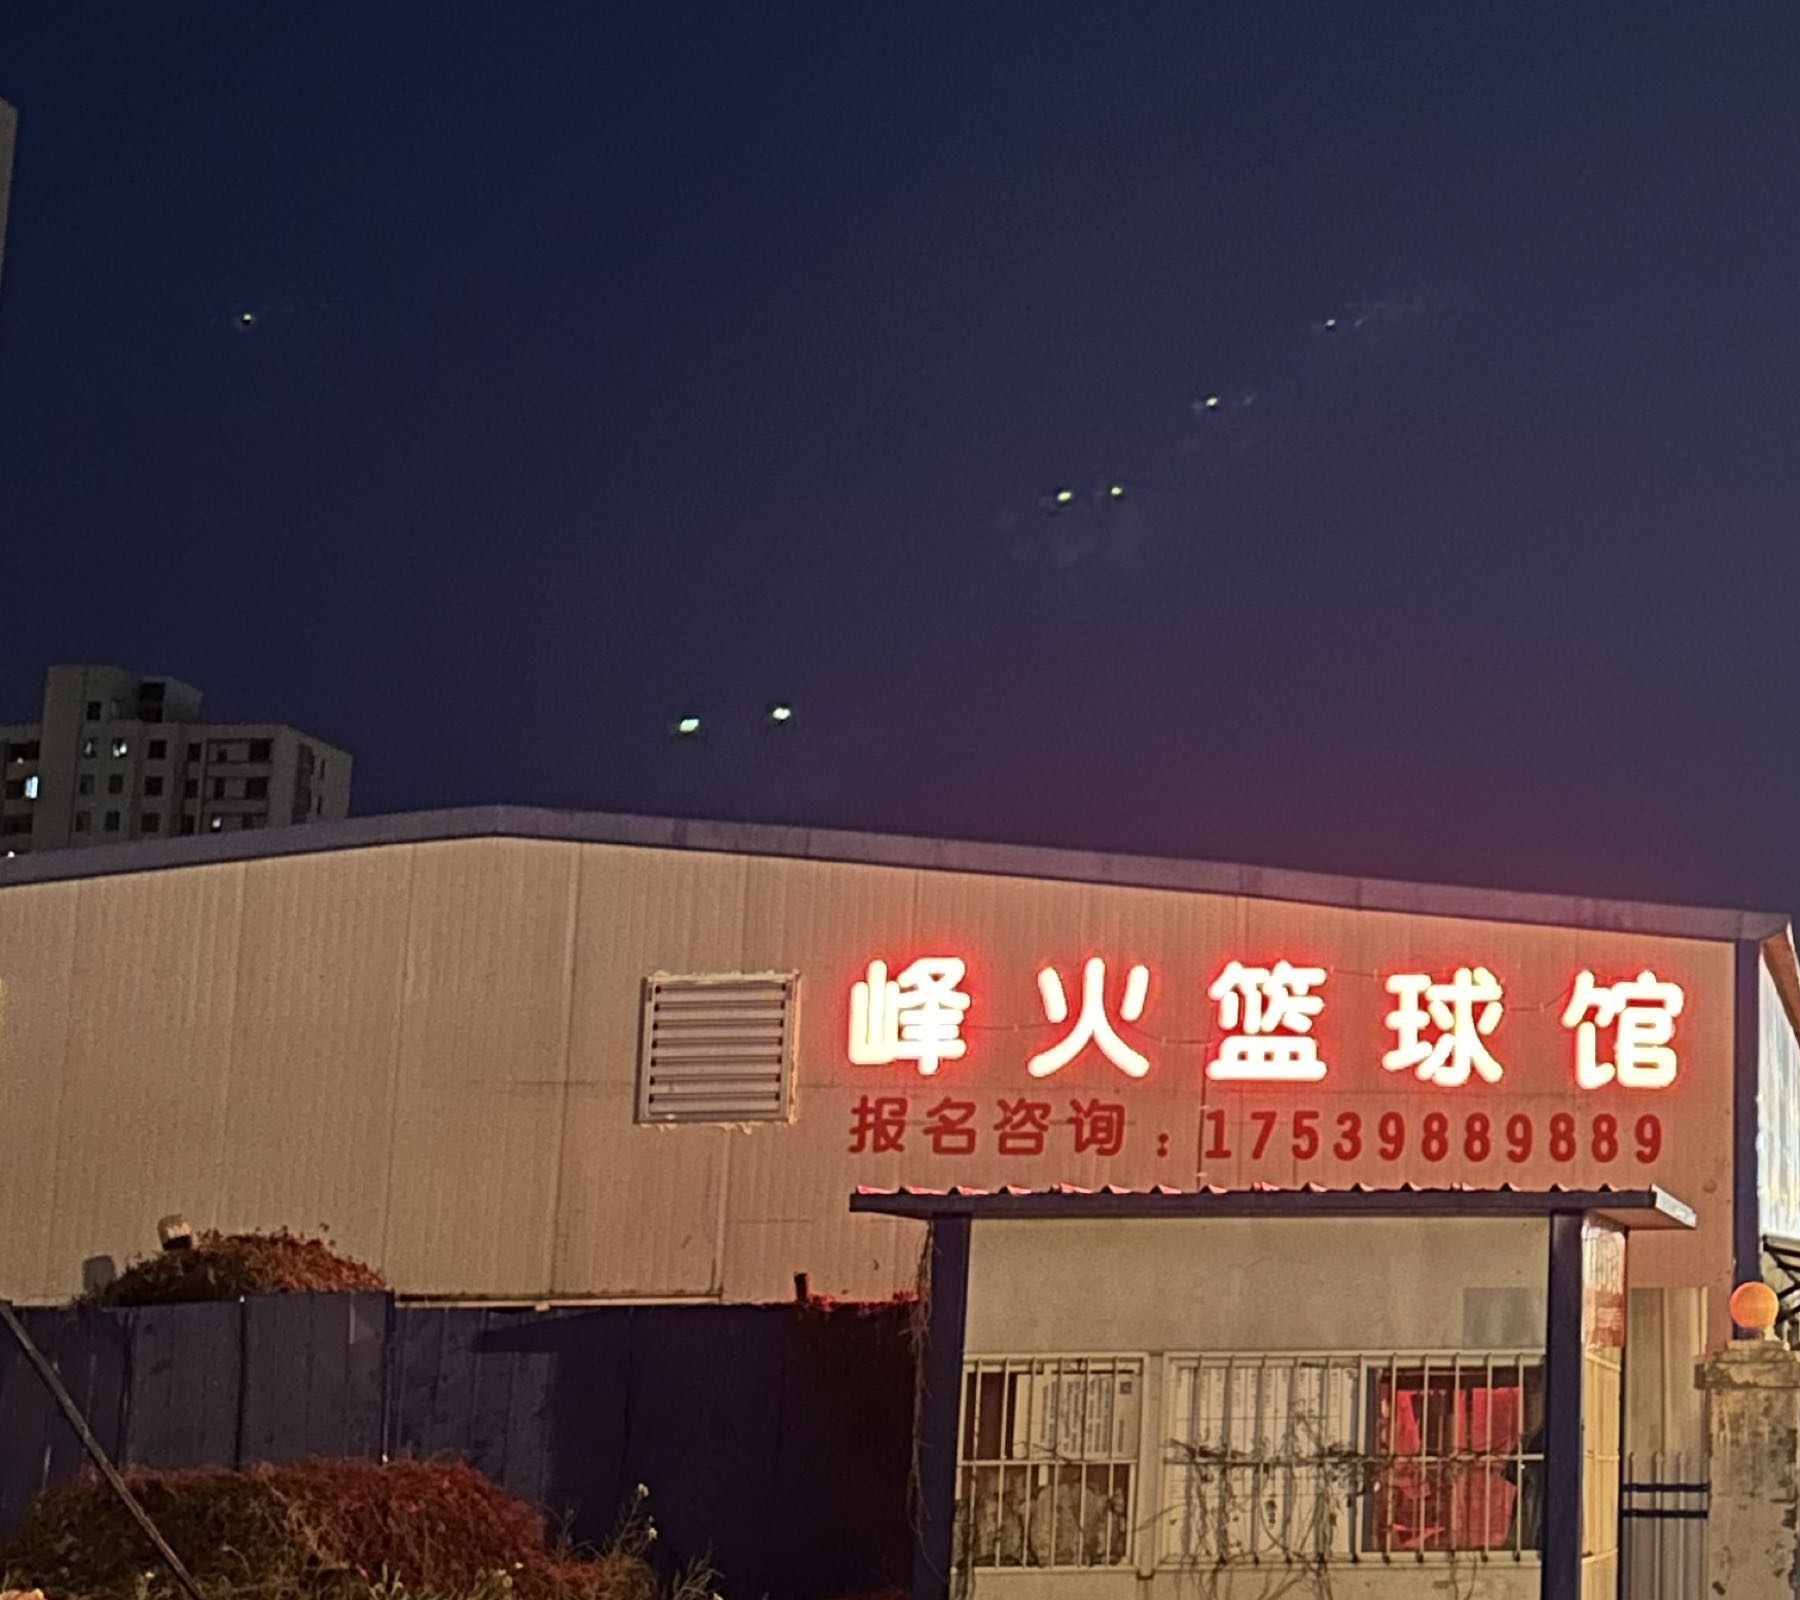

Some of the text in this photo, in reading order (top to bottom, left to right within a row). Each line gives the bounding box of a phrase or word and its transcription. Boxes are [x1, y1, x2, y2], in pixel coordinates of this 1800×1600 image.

[848, 957, 1684, 1089] 峰火篮球馆
